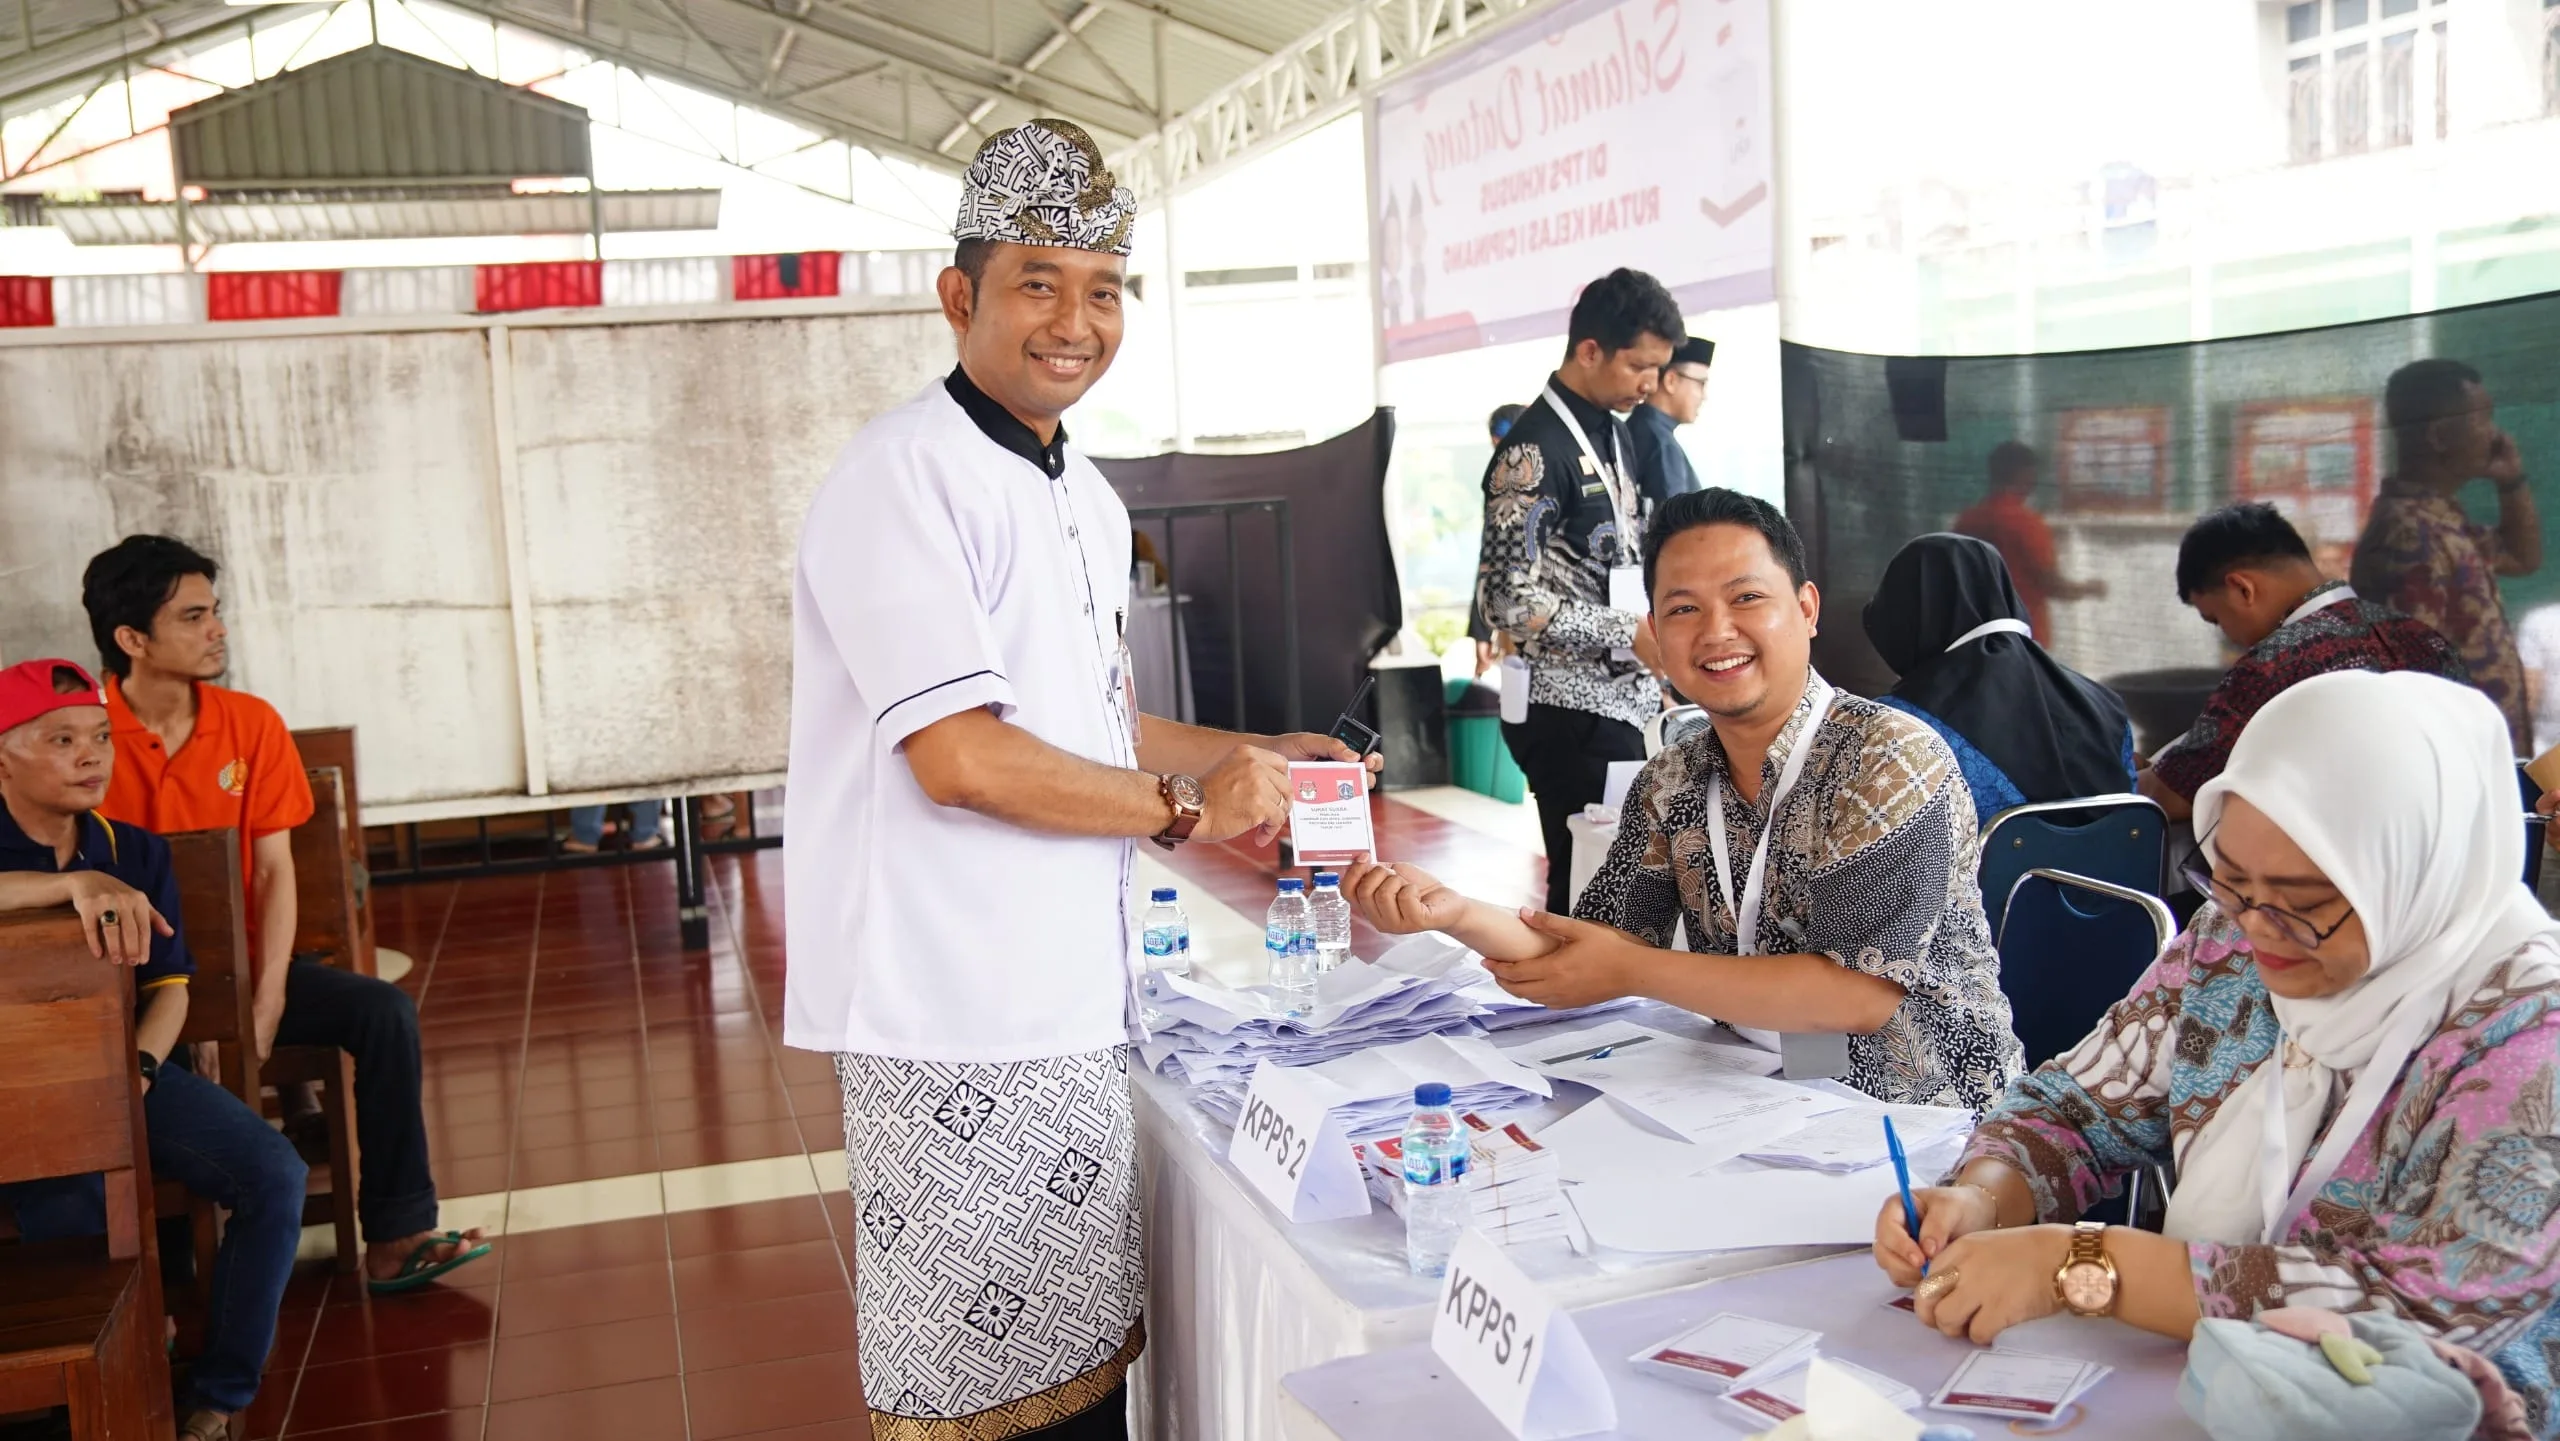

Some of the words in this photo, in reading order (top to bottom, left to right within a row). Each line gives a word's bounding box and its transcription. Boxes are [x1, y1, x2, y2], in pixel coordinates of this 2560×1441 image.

[1243, 1093, 1294, 1166] KPPS
[1287, 1138, 1306, 1180] 2
[1446, 1266, 1516, 1365] KPPS
[1518, 1334, 1534, 1384] 1
